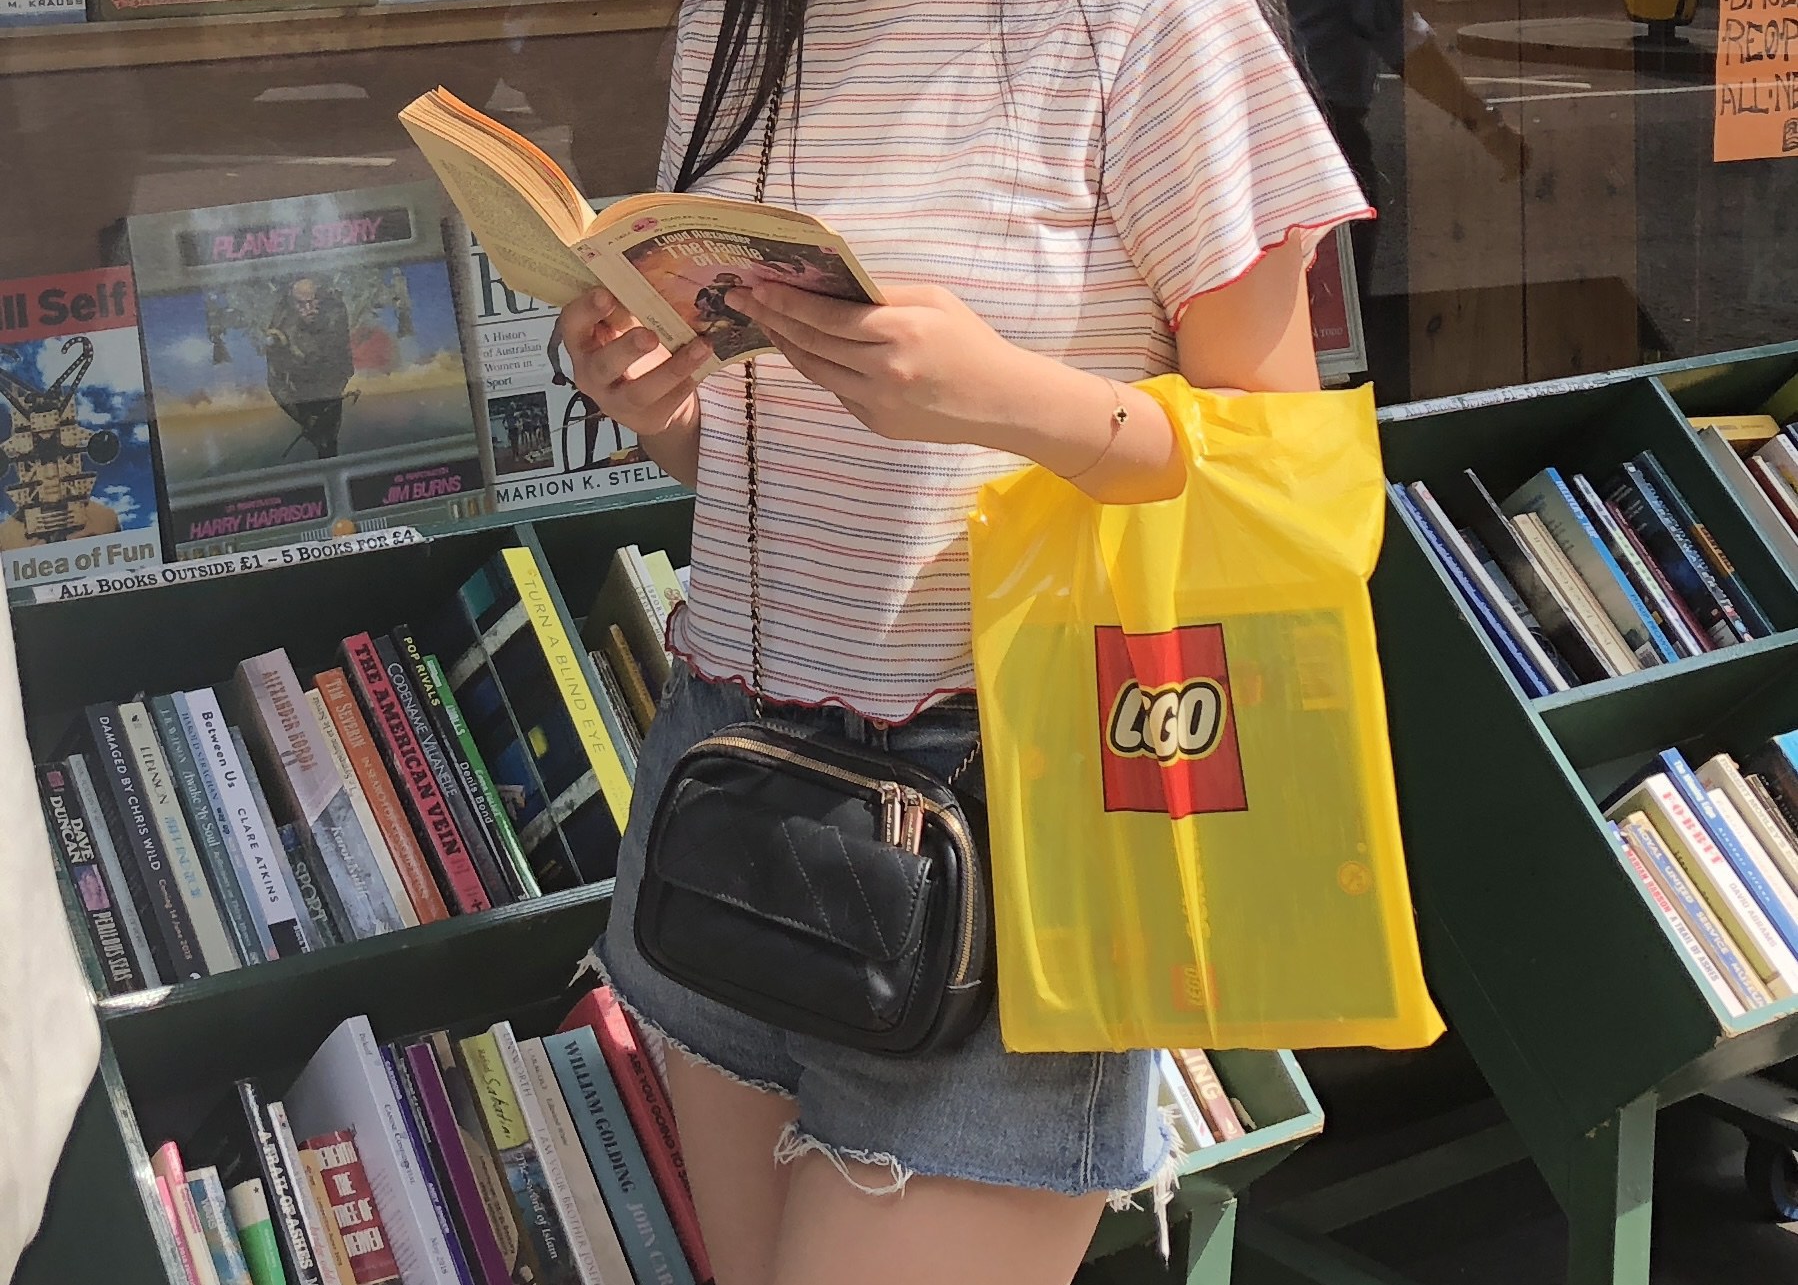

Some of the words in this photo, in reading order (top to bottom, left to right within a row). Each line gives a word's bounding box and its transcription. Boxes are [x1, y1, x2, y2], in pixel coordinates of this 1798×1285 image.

[212, 223, 297, 261] PLANET
[311, 216, 384, 248] STORY
[653, 230, 689, 248] Lloyd
[661, 240, 701, 260] The
[38, 280, 128, 325] Self
[483, 347, 493, 358] of
[494, 342, 542, 358] Australian
[485, 360, 521, 374] Women
[493, 330, 528, 345] History
[486, 376, 513, 391] Sport
[382, 484, 410, 505] JIM
[411, 475, 462, 501] BURNS
[495, 478, 575, 505] MARION
[583, 474, 601, 491] K.
[608, 467, 669, 487] STELL
[190, 517, 243, 540] HARRY
[245, 501, 324, 533] HARRISON
[13, 558, 70, 582] Idea
[75, 547, 101, 572] of
[106, 540, 155, 566] Fun
[59, 579, 93, 600] ALL
[97, 572, 158, 595] BOOKS
[161, 560, 236, 584] OUTSIDE
[239, 554, 262, 572] £1
[282, 548, 293, 565] 5
[298, 539, 355, 563] BOOKS
[357, 534, 390, 554] FOR
[403, 636, 421, 664] POP
[415, 664, 441, 708] RIVALS
[524, 579, 552, 628] TURN
[549, 636, 561, 648] A
[555, 654, 588, 711] BLIND
[583, 718, 607, 754] EYE
[262, 670, 301, 732] ALEXANDER
[325, 678, 345, 700] TIM
[335, 702, 365, 749] SEVERIN
[386, 661, 429, 736] CODENAME
[421, 733, 458, 799] VILLANELLE
[98, 715, 128, 775] DAMAGED
[355, 643, 383, 684] THE
[374, 687, 436, 799] AMERICAN
[428, 802, 462, 856] VEIN
[120, 775, 135, 794] BY
[127, 794, 149, 836] CHRIS
[201, 710, 228, 768] Between
[223, 770, 236, 789] Us
[237, 808, 260, 850] CLARE
[254, 855, 280, 904] ATKINS
[459, 761, 479, 795] Denis
[473, 794, 494, 825] Bond
[49, 795, 85, 865] DUNCAN
[70, 817, 95, 861] DAVE
[142, 835, 161, 871] WILD
[203, 820, 221, 848] Soul
[294, 860, 329, 924] SPORT
[1632, 823, 1663, 860] ROYAL
[1663, 865, 1695, 905] UNITED
[1696, 907, 1730, 955] SERVICE
[1661, 790, 1725, 865] FOBBIT
[1728, 882, 1751, 914] DAVID
[1747, 909, 1778, 950] ABRAMS
[92, 910, 122, 958] PERILOUS
[107, 957, 134, 983] SEAS
[1673, 919, 1692, 945] TRAIL
[1697, 953, 1720, 984] ASHES
[627, 1052, 643, 1078] ARE
[639, 1079, 657, 1104] YOU
[653, 1104, 676, 1148] GOING
[502, 1032, 533, 1097] UNSWORTH
[560, 1195, 586, 1251] BROTHER
[563, 1039, 604, 1116] WILLIAM
[594, 1117, 637, 1196] GOLDING
[625, 1202, 656, 1248] JOHN
[262, 1144, 290, 1198] TRAIL
[285, 1217, 314, 1271] ASHES
